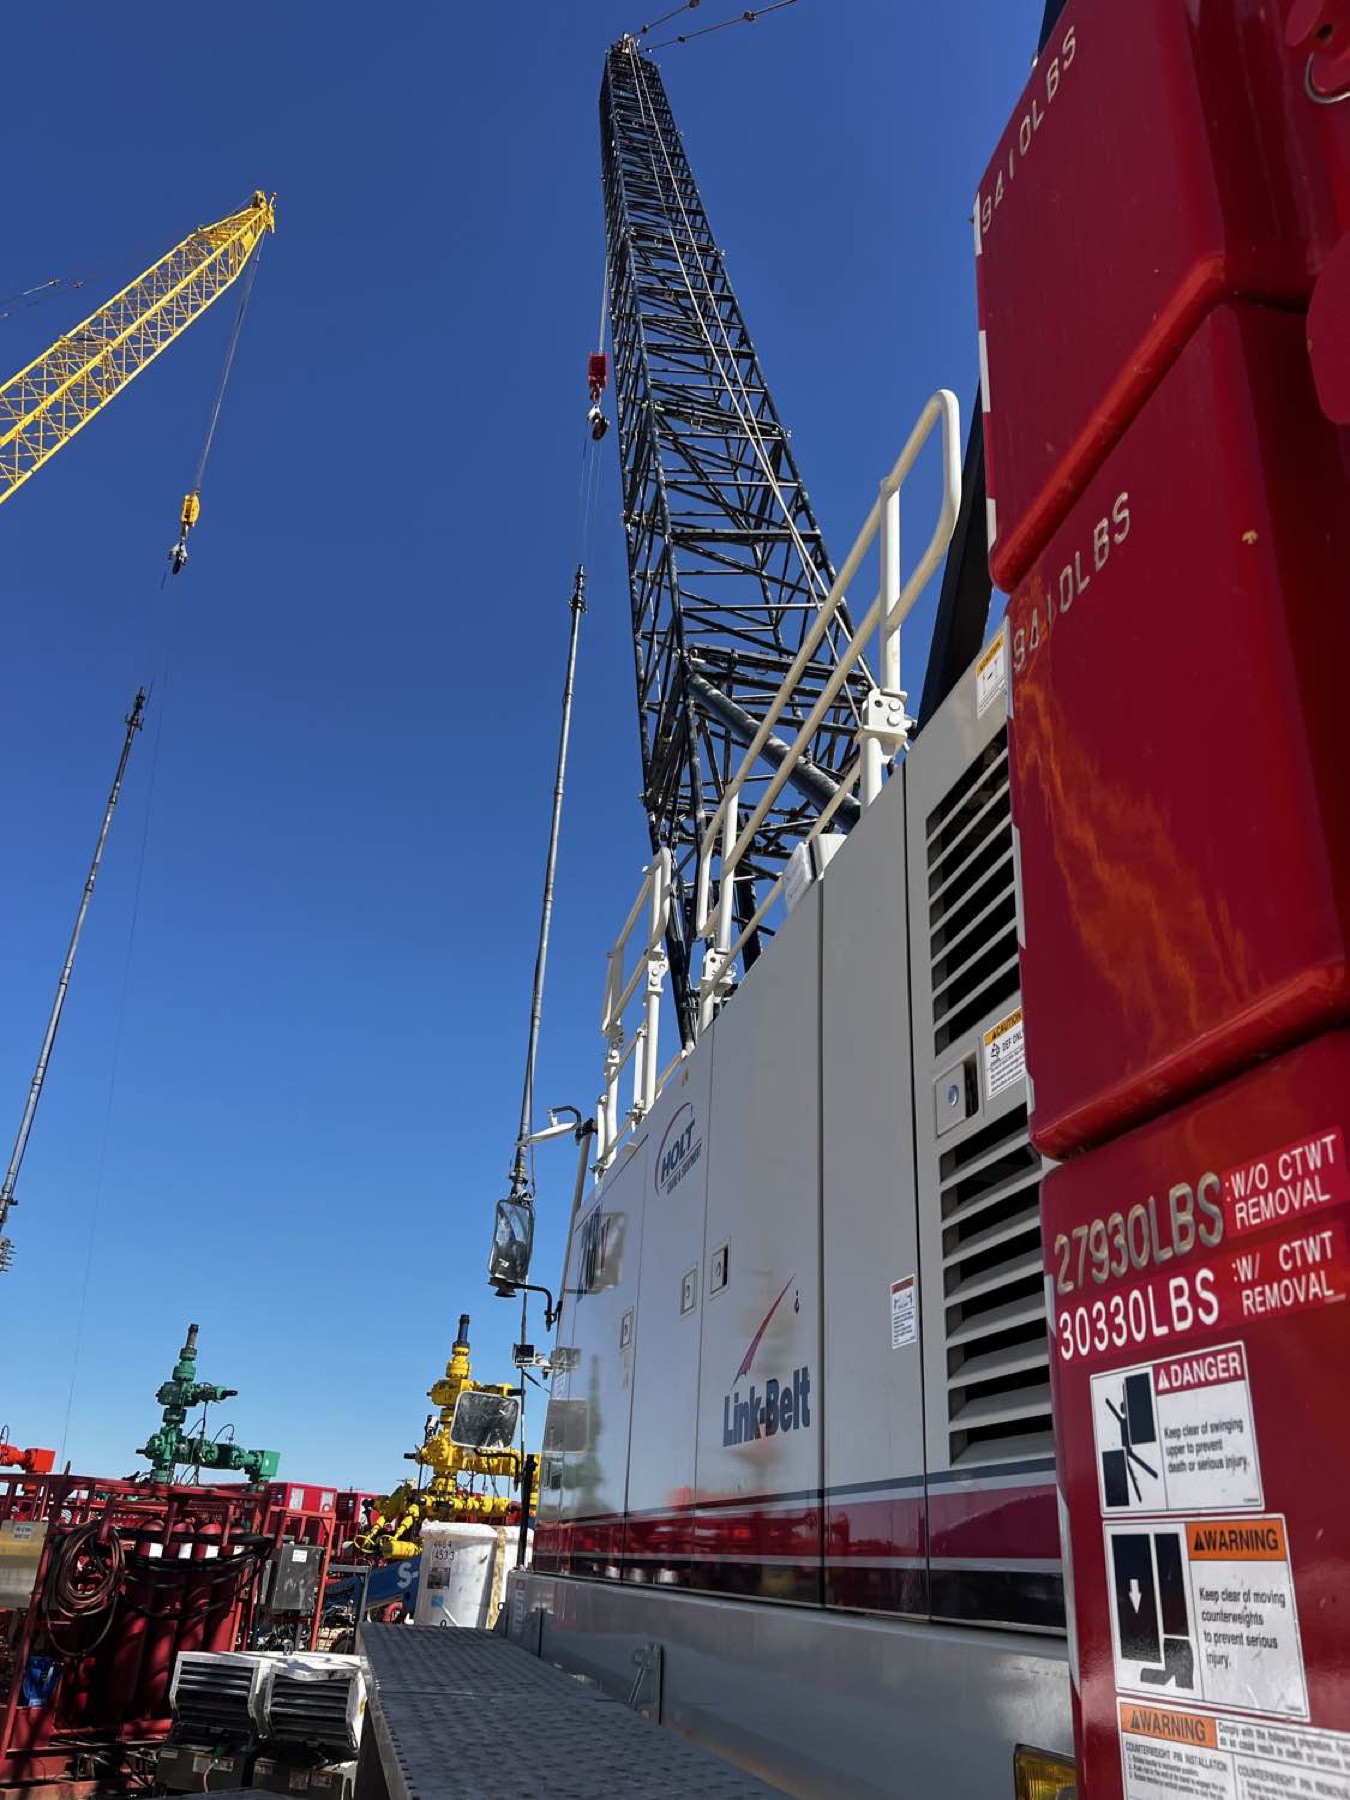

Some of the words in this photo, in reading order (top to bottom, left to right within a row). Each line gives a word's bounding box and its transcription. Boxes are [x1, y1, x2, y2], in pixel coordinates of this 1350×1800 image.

[661, 1117, 695, 1184] HOLT
[1054, 1171, 1225, 1296] 27930LBS
[1278, 1134, 1337, 1182] CTWT
[1235, 1175, 1331, 1230] REMOVAL
[1059, 1268, 1220, 1361] 30330LBS
[1278, 1231, 1334, 1272] CTWT
[1241, 1270, 1335, 1316] REMOVAL
[1170, 1352, 1242, 1387] DANGER
[722, 1366, 811, 1448] Link-Belt
[1164, 1426, 1182, 1440] Keep
[1183, 1424, 1199, 1437] clear
[1201, 1421, 1208, 1434] of
[1210, 1418, 1243, 1434] swinging
[1166, 1445, 1185, 1458] upper
[1187, 1442, 1194, 1454] to
[1195, 1439, 1223, 1456] prevent
[1168, 1459, 1187, 1473] death
[1188, 1460, 1196, 1471] or
[1197, 1455, 1224, 1471] serious
[1204, 1528, 1279, 1552] WARNING
[1199, 1588, 1220, 1605] Keep
[1221, 1588, 1241, 1602] clear
[1243, 1588, 1251, 1602] of
[1253, 1589, 1286, 1609] moving
[1201, 1609, 1264, 1628] counterweights
[1204, 1630, 1212, 1643] to
[1214, 1630, 1244, 1647] prevent
[1246, 1634, 1278, 1649] serious
[1140, 1710, 1206, 1741] WARNING
